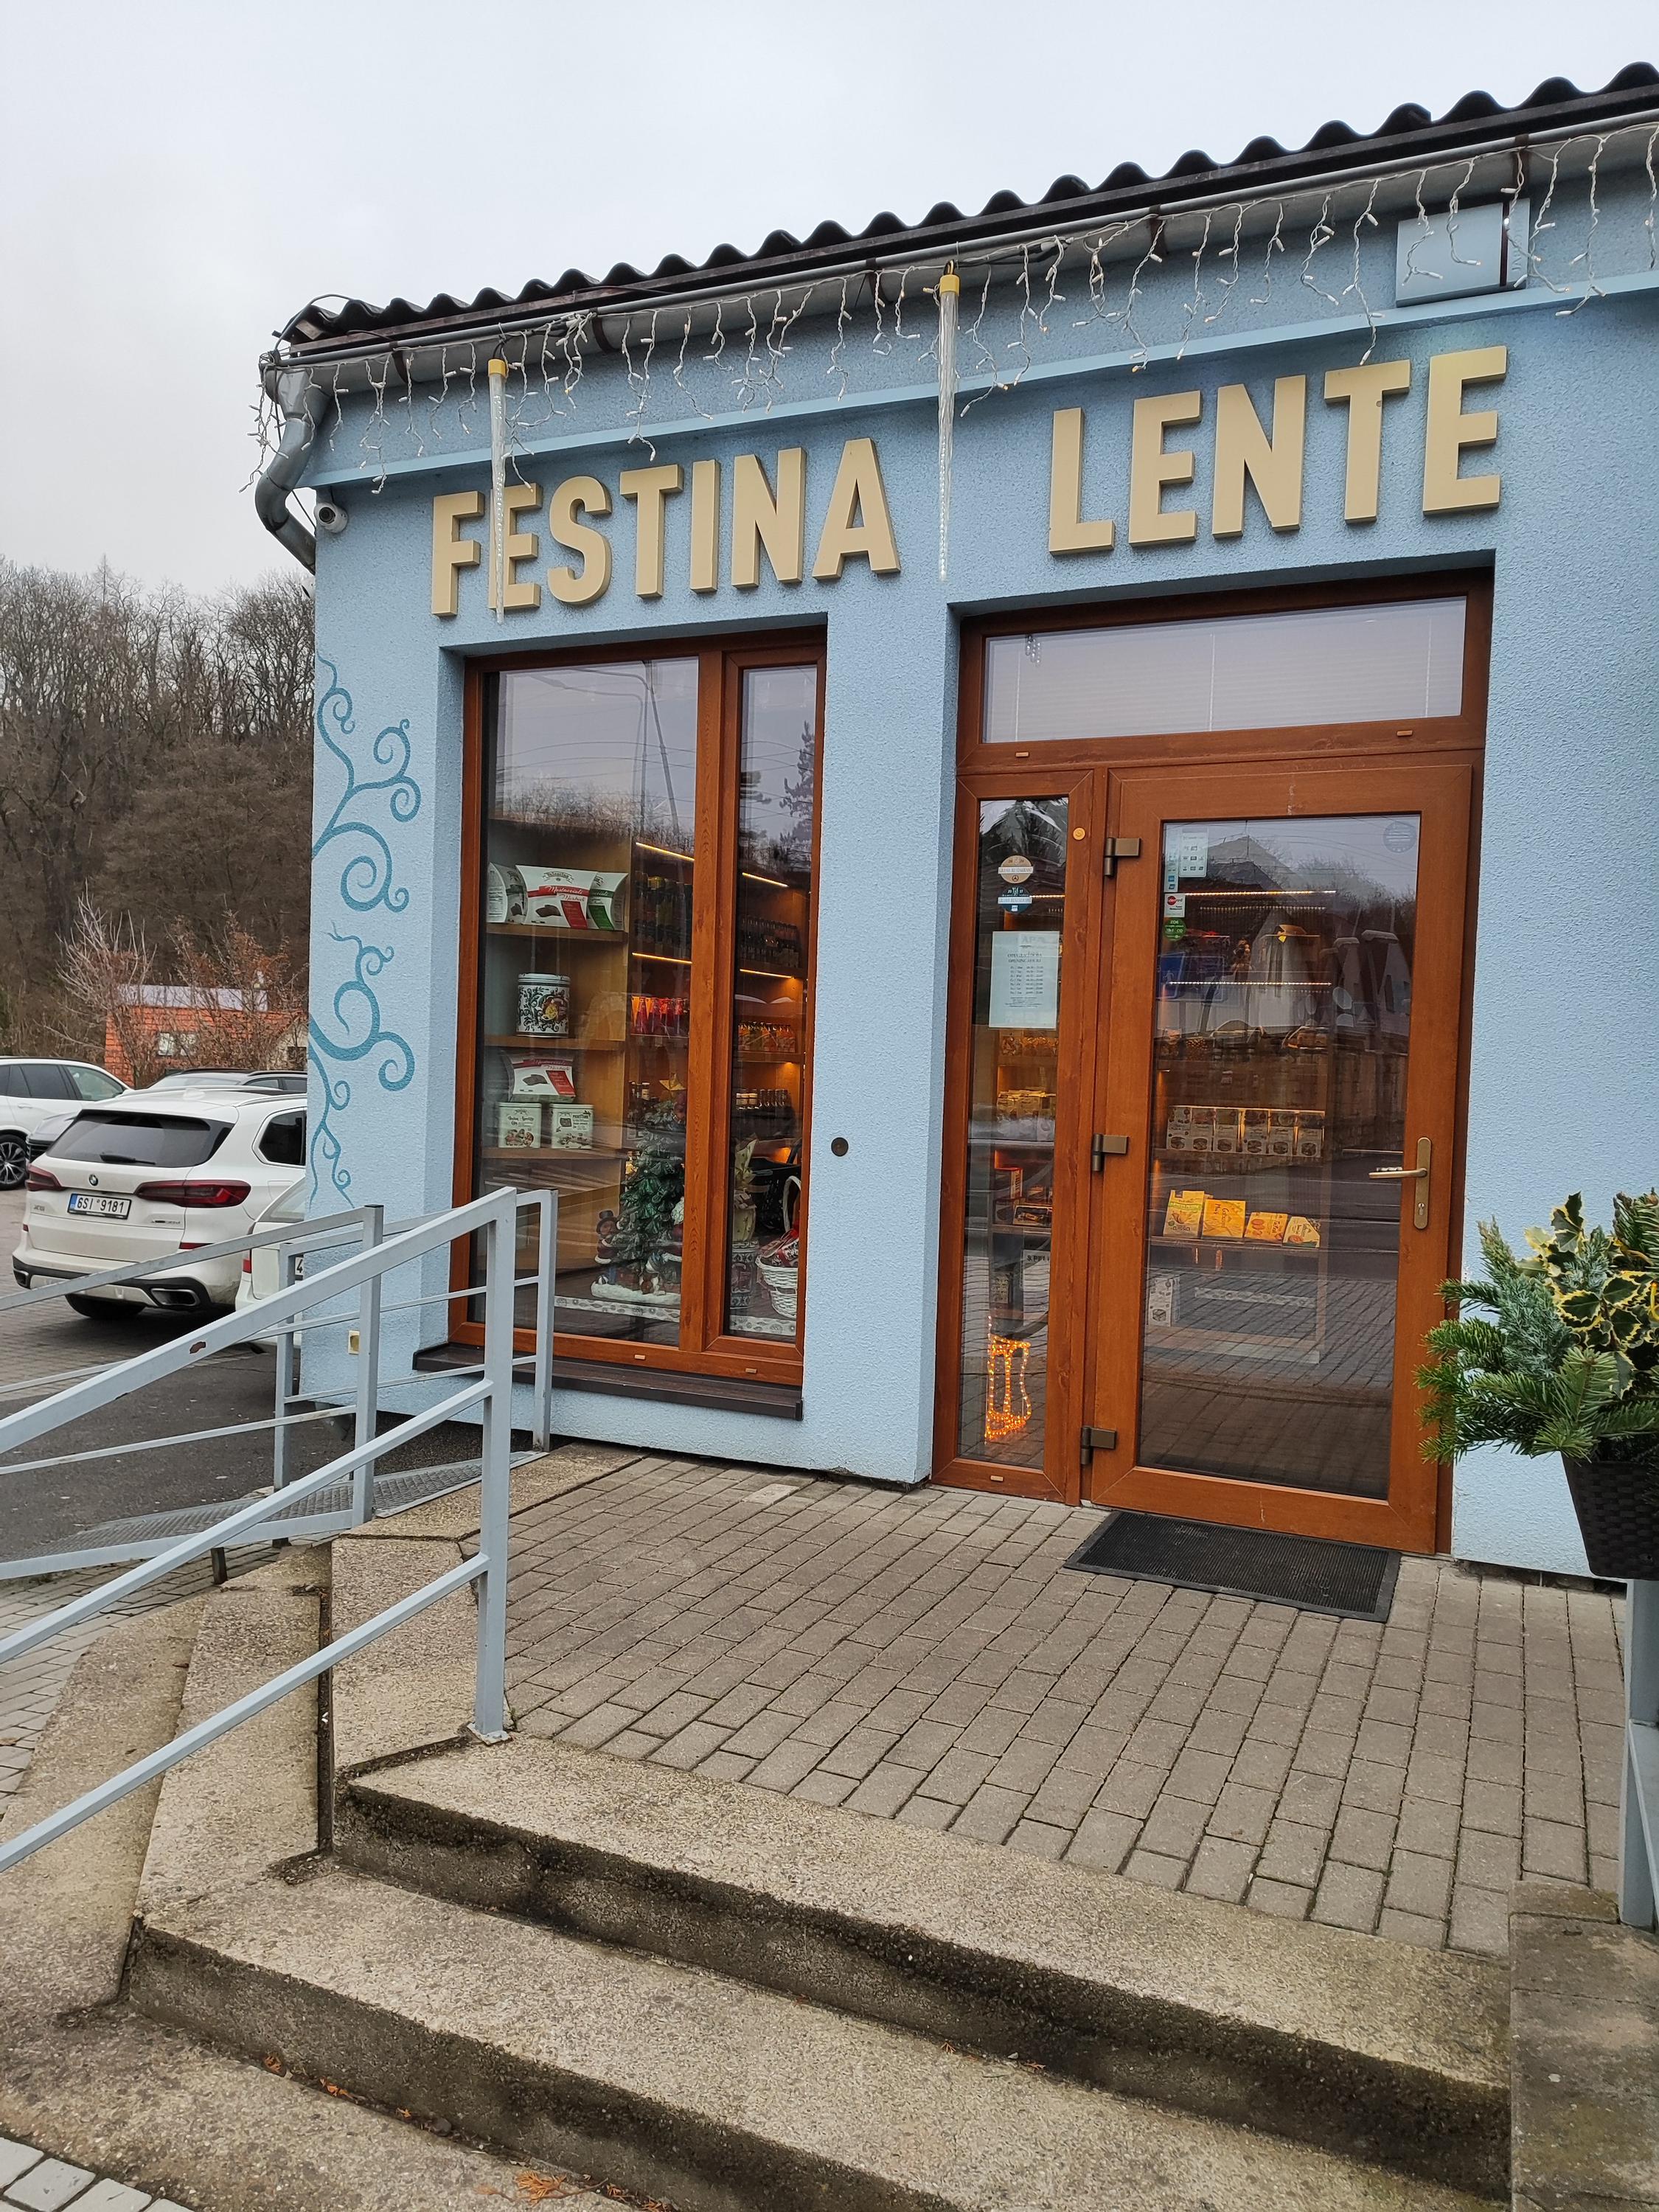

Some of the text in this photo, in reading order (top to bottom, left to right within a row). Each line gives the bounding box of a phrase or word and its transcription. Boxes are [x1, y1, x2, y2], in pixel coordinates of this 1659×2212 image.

[431, 345, 1508, 617] FESTINA LENTE
[100, 1200, 125, 1214] 9181
